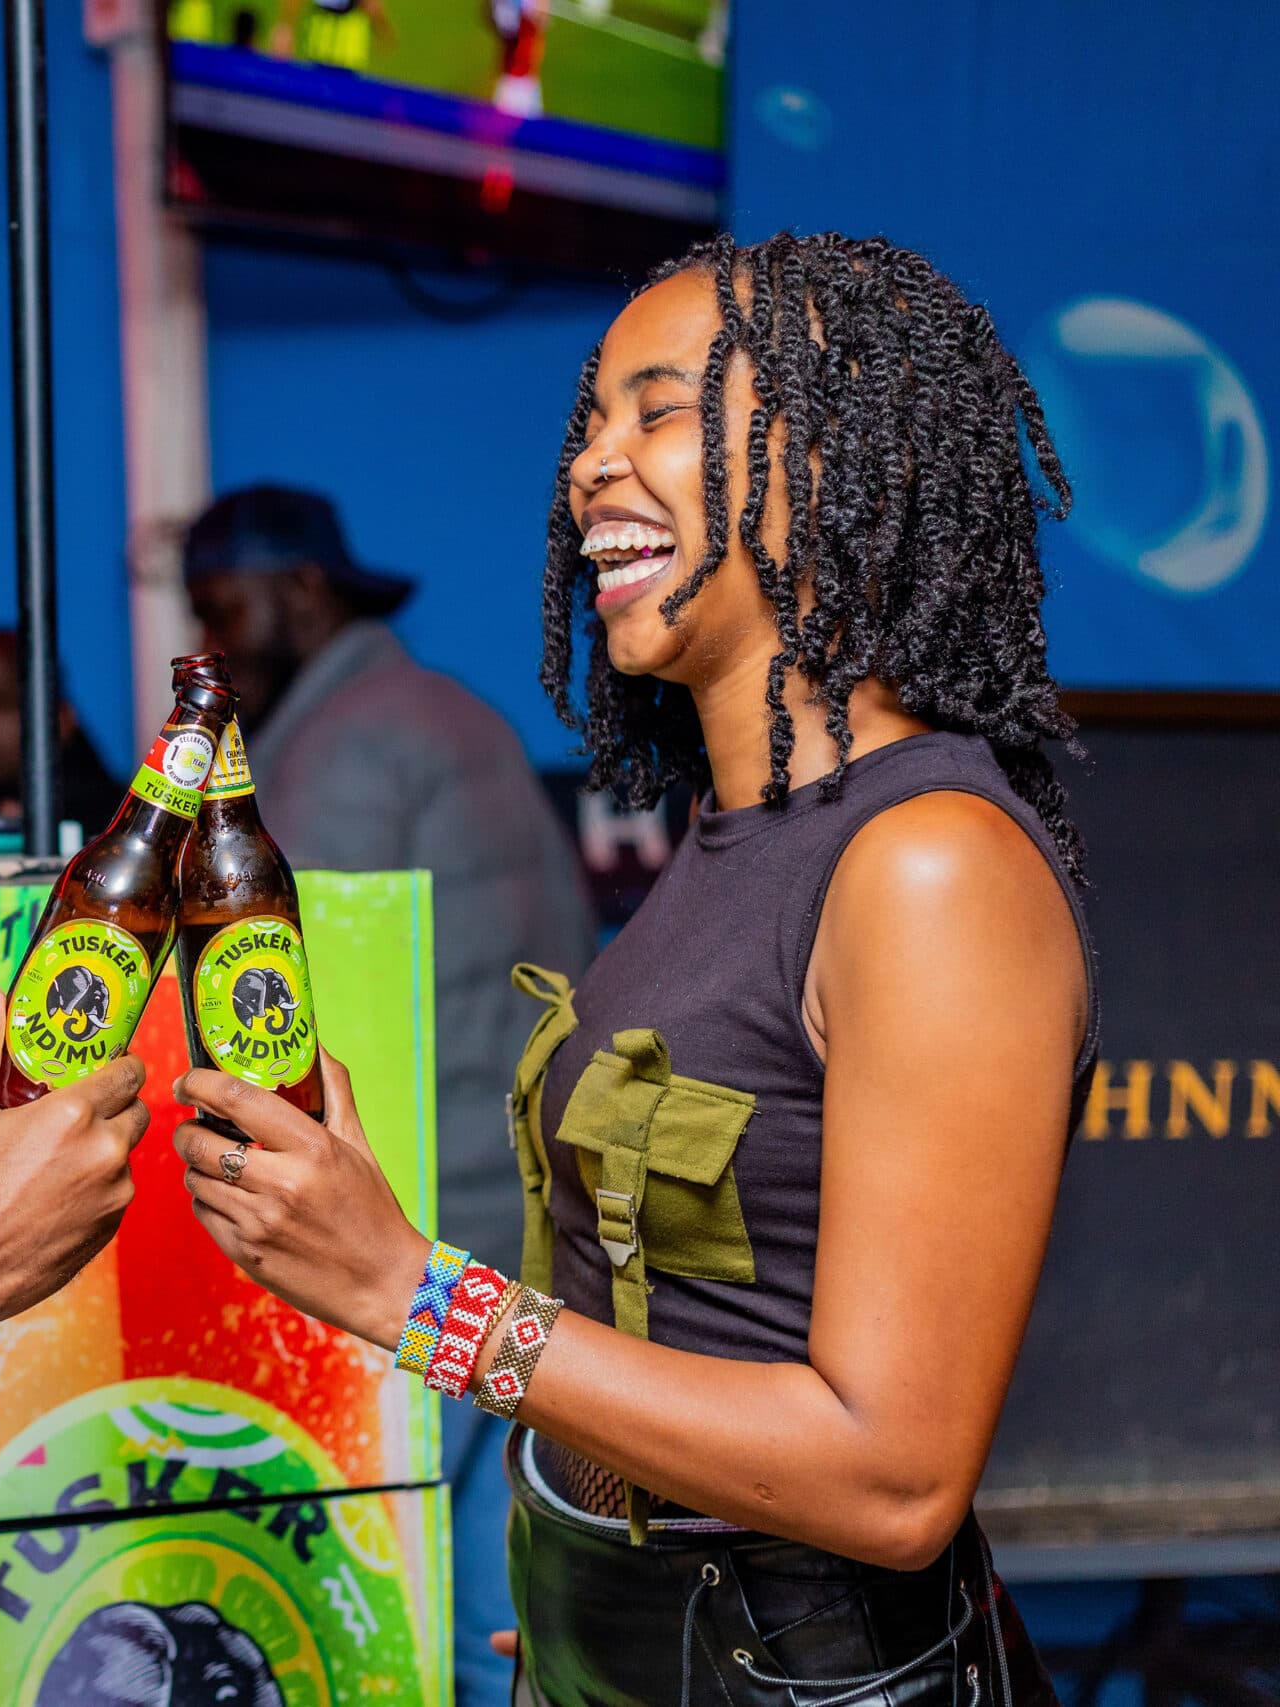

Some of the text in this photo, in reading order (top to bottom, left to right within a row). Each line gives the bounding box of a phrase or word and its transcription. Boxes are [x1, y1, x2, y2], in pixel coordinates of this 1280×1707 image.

[144, 781, 198, 815] TUSKER
[59, 935, 137, 978] TUSKER
[215, 933, 292, 969] TUSKER
[26, 1011, 106, 1065] NDIMU
[230, 1018, 309, 1059] NDIMU
